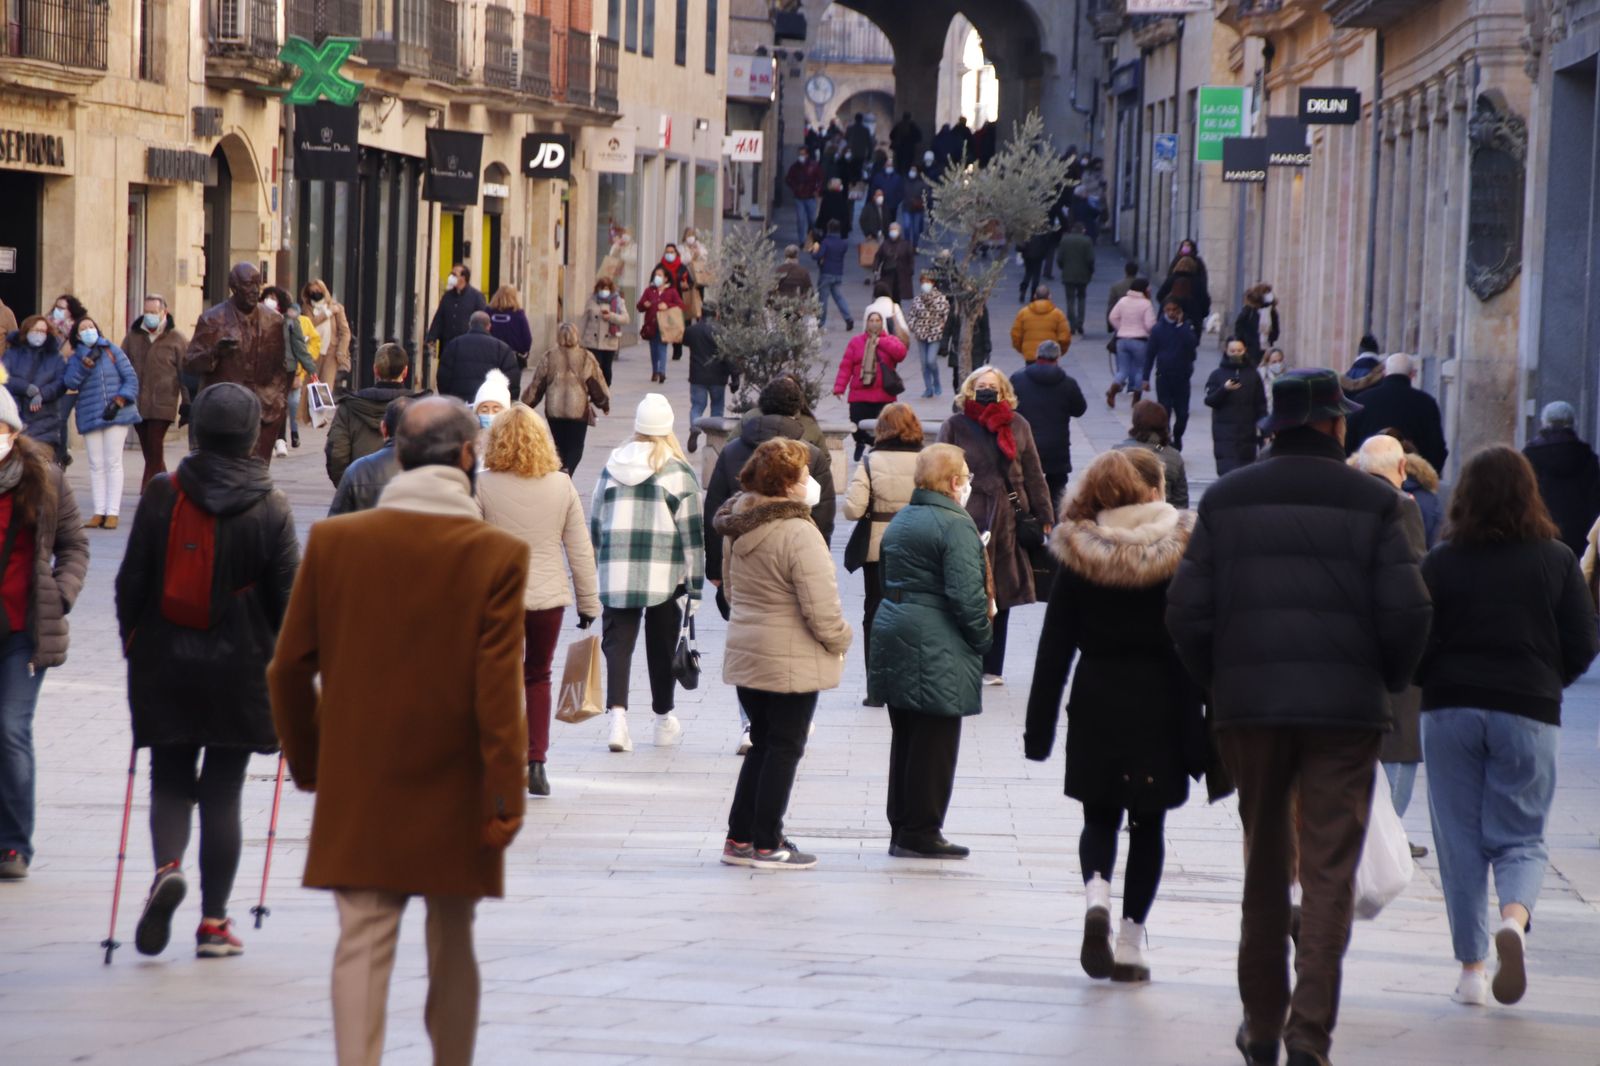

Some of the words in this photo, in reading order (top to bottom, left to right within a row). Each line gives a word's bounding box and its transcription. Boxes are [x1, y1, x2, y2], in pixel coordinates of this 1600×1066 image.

[1306, 98, 1348, 114] DRUNI
[529, 142, 565, 169] JD
[1225, 170, 1266, 180] MANGO
